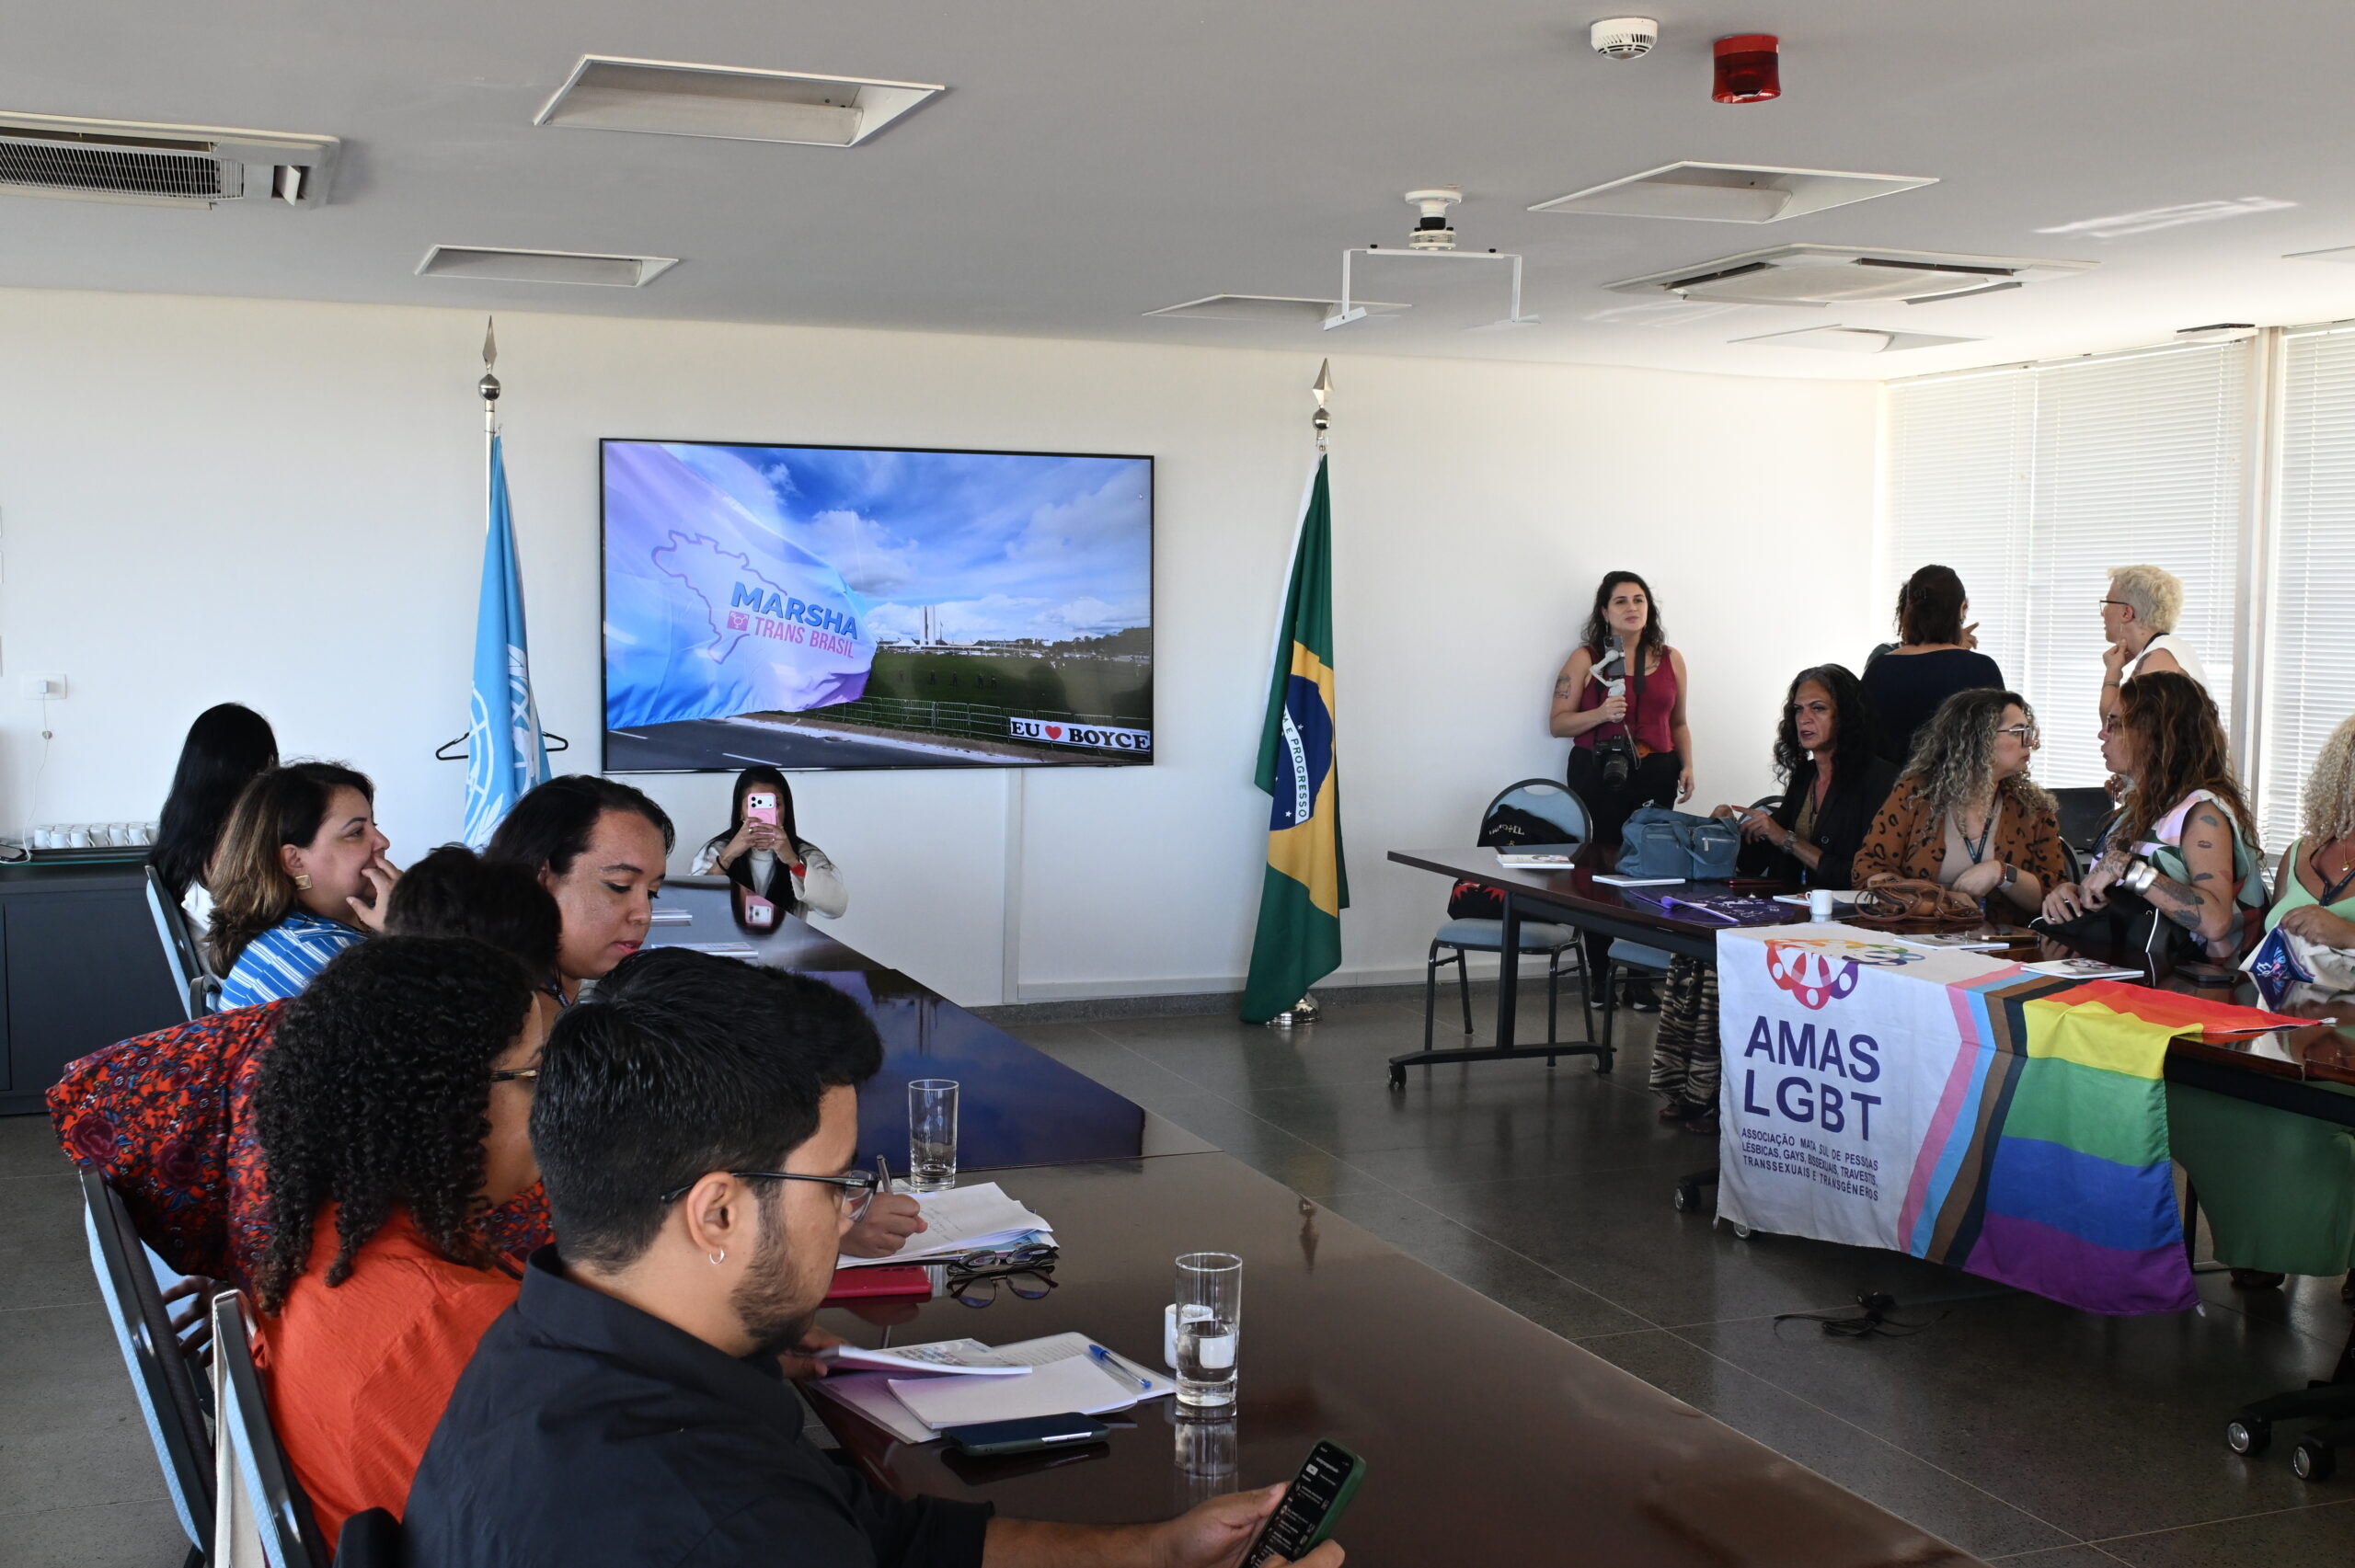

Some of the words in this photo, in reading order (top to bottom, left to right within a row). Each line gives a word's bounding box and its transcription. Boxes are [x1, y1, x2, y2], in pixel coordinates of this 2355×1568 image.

[731, 581, 857, 639] MARSHA
[754, 616, 805, 644] TRANS
[810, 631, 854, 658] BRASIL
[1011, 721, 1040, 737] EU
[1068, 727, 1150, 750] BOYCE
[1291, 738, 1307, 818] PROGRESSO
[1744, 1015, 1880, 1083] AMAS
[1744, 1069, 1881, 1141] LGBT
[1741, 1127, 1795, 1147] ASSOCIAÇÃO
[1800, 1138, 1816, 1151] MATA
[1819, 1144, 1829, 1157] SUL
[1832, 1149, 1841, 1161] DE
[1845, 1152, 1878, 1171] PESSOAS
[1743, 1155, 1810, 1178] TRANSSEXUAIS
[1812, 1171, 1817, 1182] E
[1784, 1150, 1807, 1164] GAYS,
[1841, 1166, 1878, 1187] TRAVESTIS,
